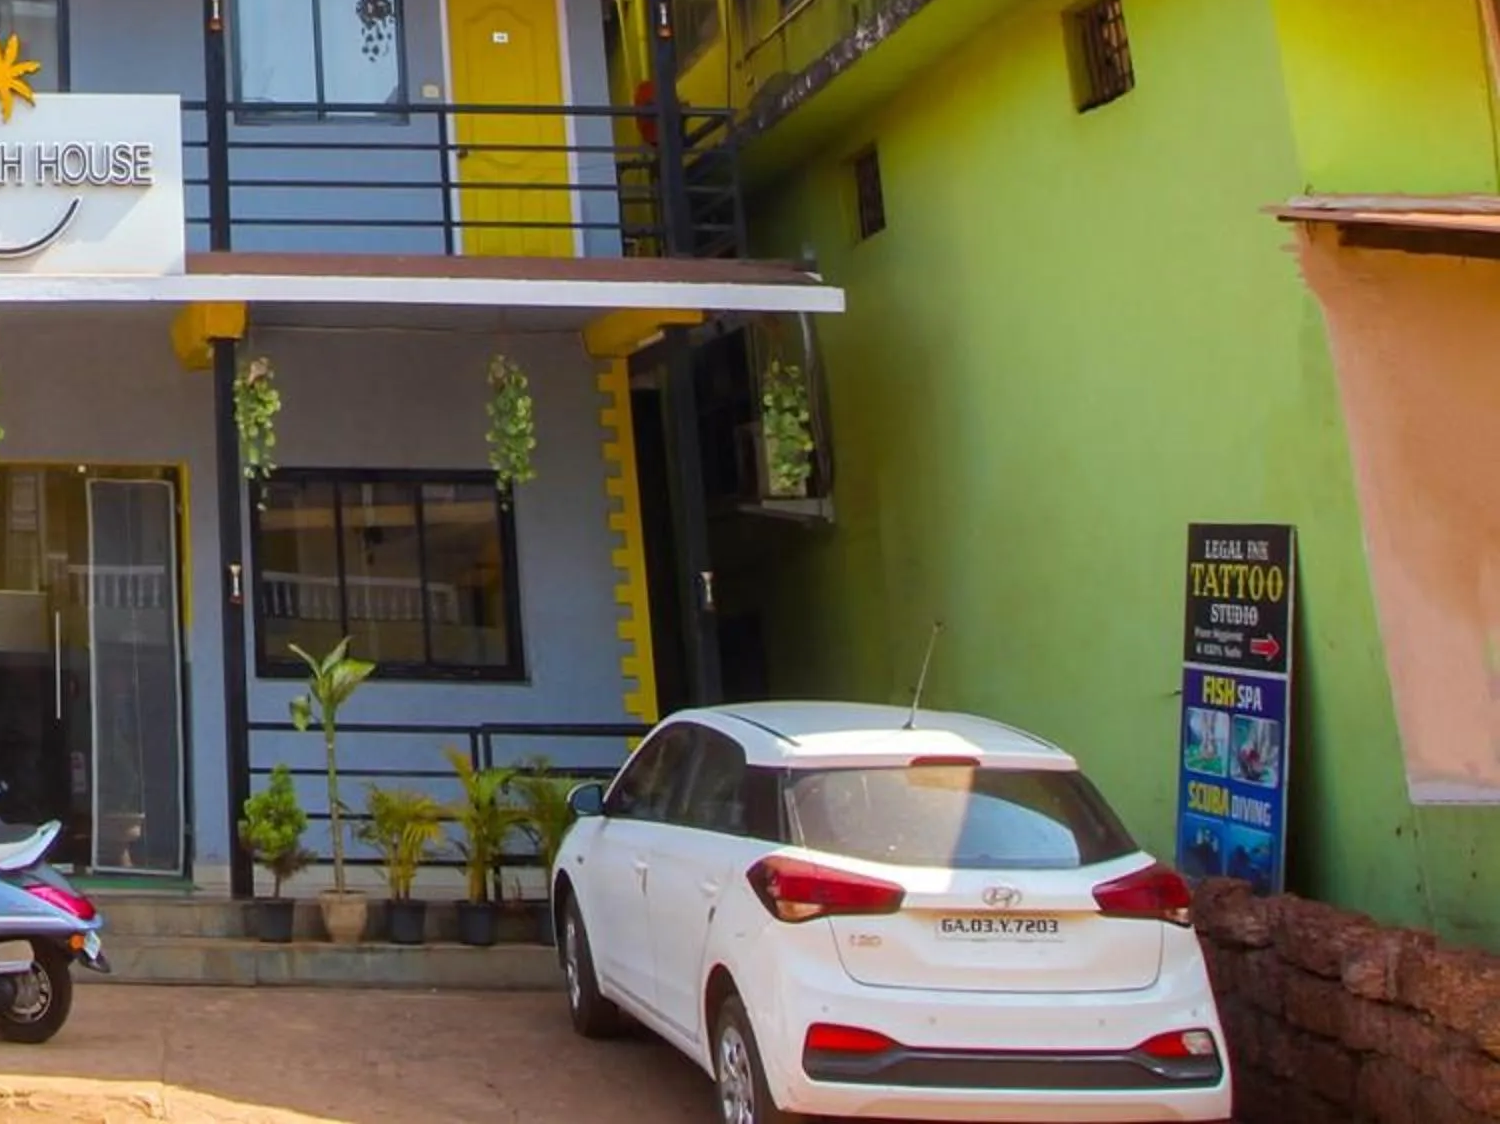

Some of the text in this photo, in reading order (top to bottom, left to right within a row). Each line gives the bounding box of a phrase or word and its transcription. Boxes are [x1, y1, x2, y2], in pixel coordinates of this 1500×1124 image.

[35, 140, 154, 187] HOUSE
[1204, 539, 1244, 559] LEGAL
[1190, 562, 1284, 602] TATTOO
[1209, 603, 1259, 626] STUDIO
[1202, 675, 1263, 711] FISH SPA
[1187, 779, 1272, 827] SCUBA DIVING
